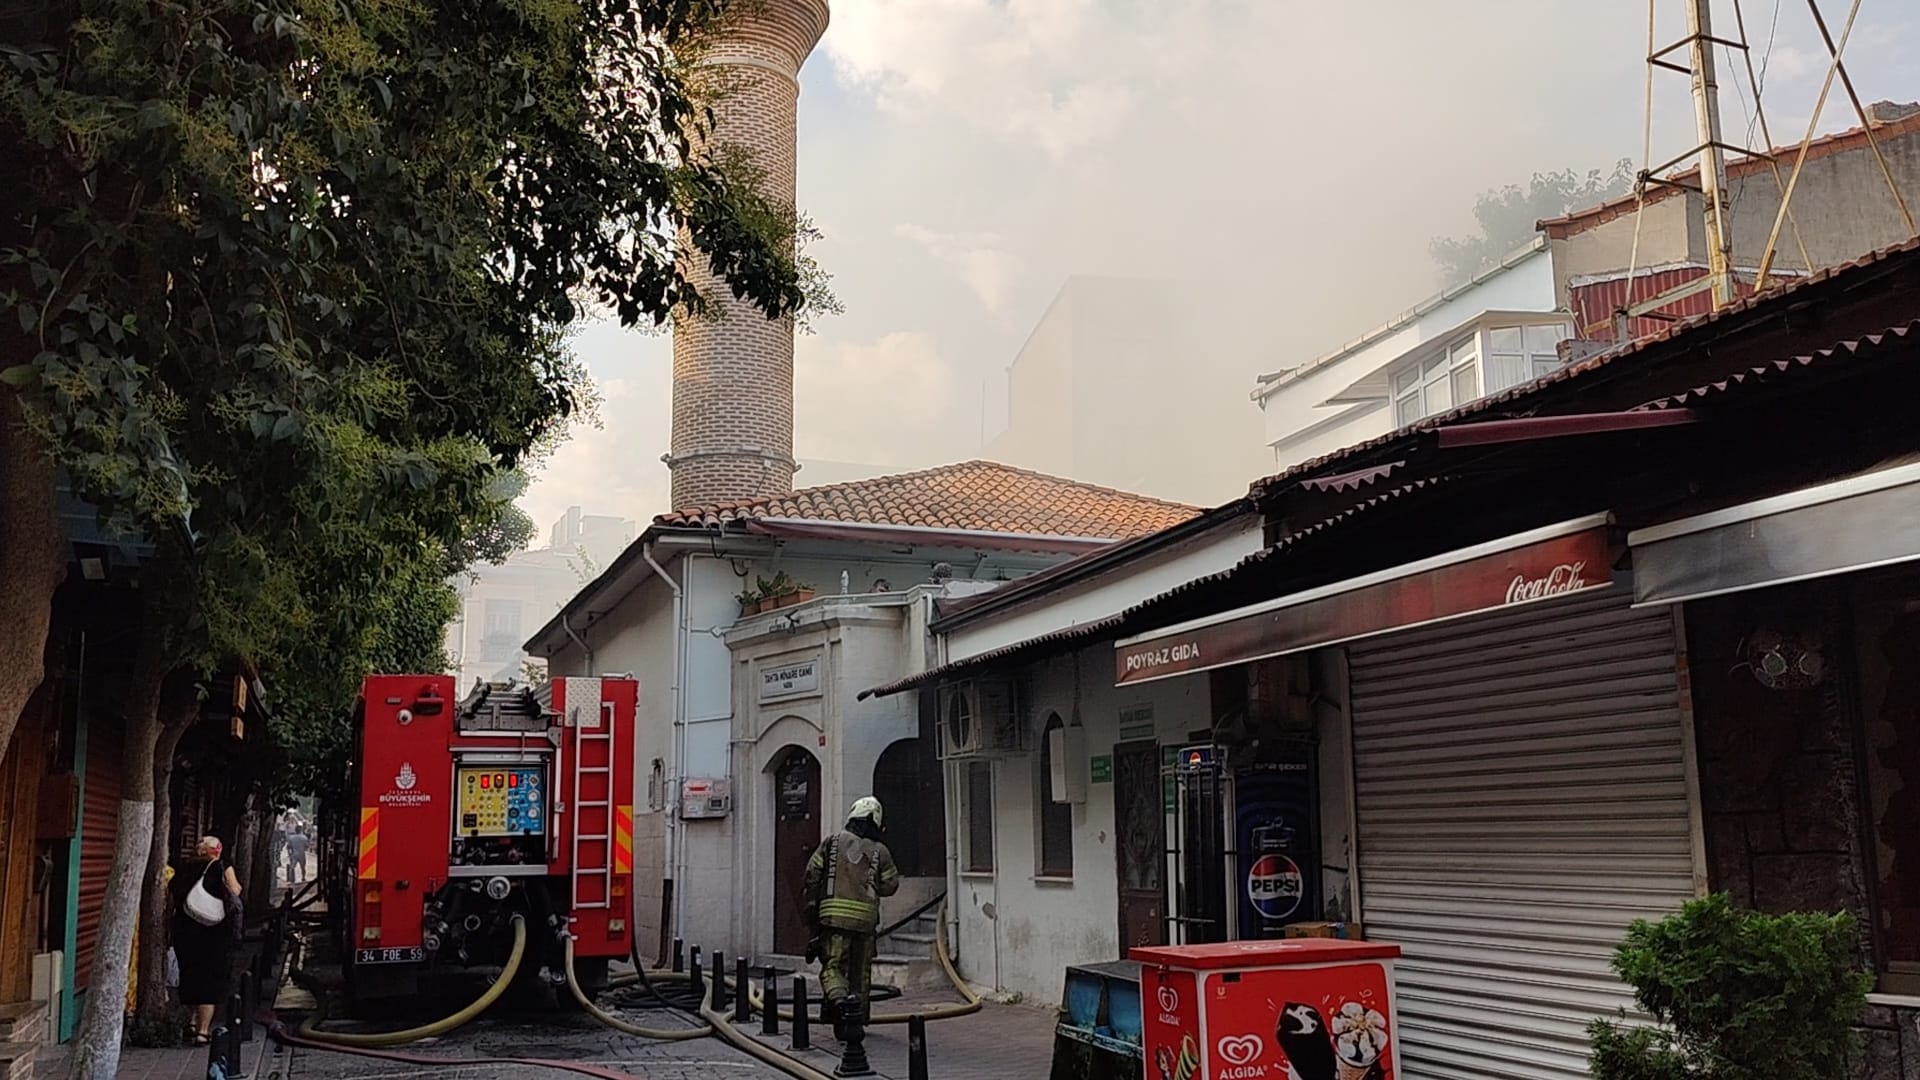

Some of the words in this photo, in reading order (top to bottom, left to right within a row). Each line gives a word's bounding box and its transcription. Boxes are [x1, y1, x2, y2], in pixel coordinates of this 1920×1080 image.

[1127, 648, 1169, 671] POYRAZ
[1171, 642, 1200, 662] GIDA
[379, 792, 431, 803] BÜYÜKŞEHİR
[1252, 878, 1300, 893] PEPSI
[362, 950, 375, 961] 34
[383, 949, 402, 960] FOE
[410, 948, 423, 960] 59
